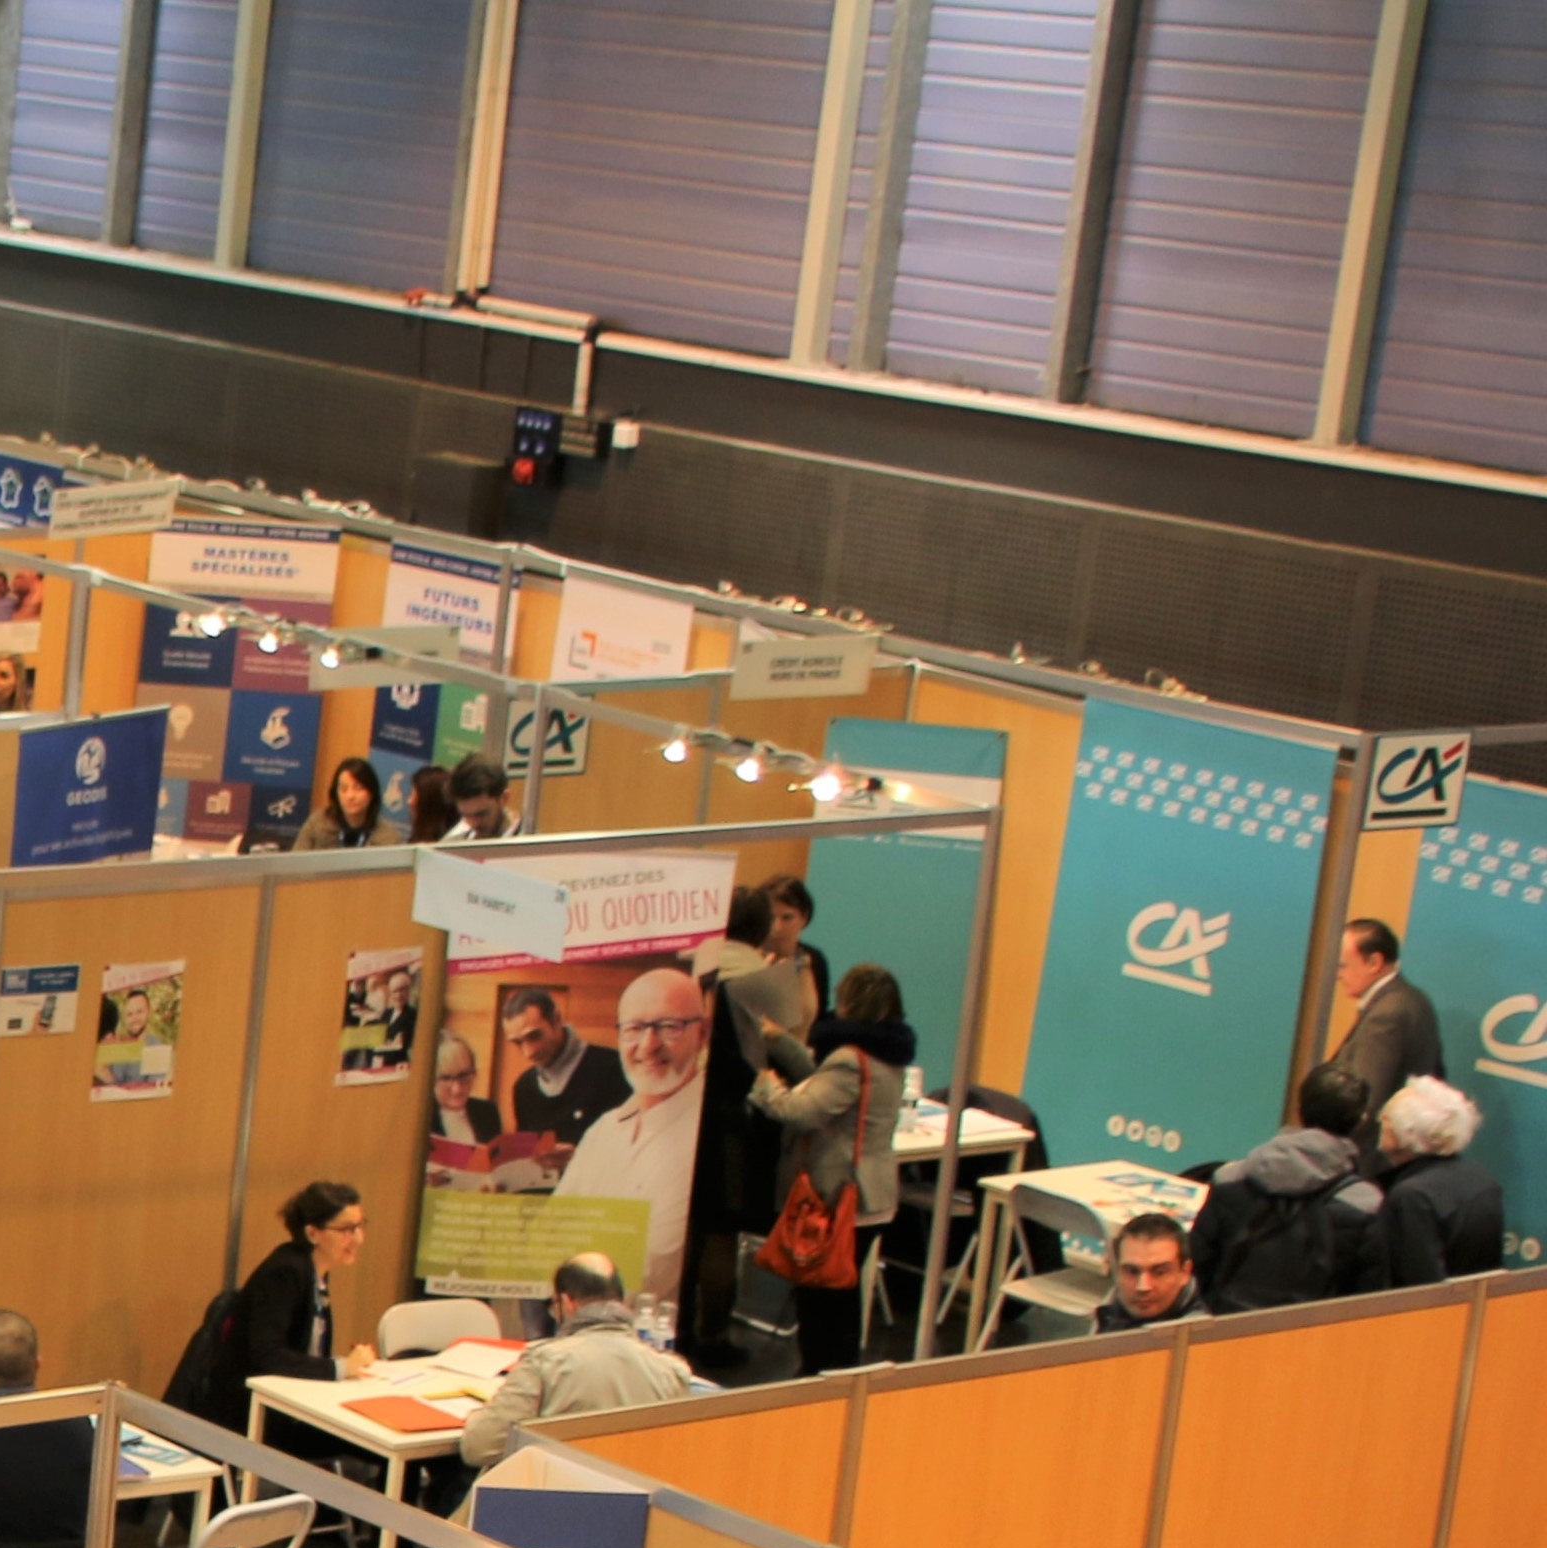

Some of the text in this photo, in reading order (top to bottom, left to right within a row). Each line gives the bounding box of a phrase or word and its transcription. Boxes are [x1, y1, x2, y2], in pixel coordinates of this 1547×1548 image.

[424, 587, 480, 611] FUTURS
[636, 869, 664, 885] DES
[602, 888, 719, 931] QUOTIDIEN
